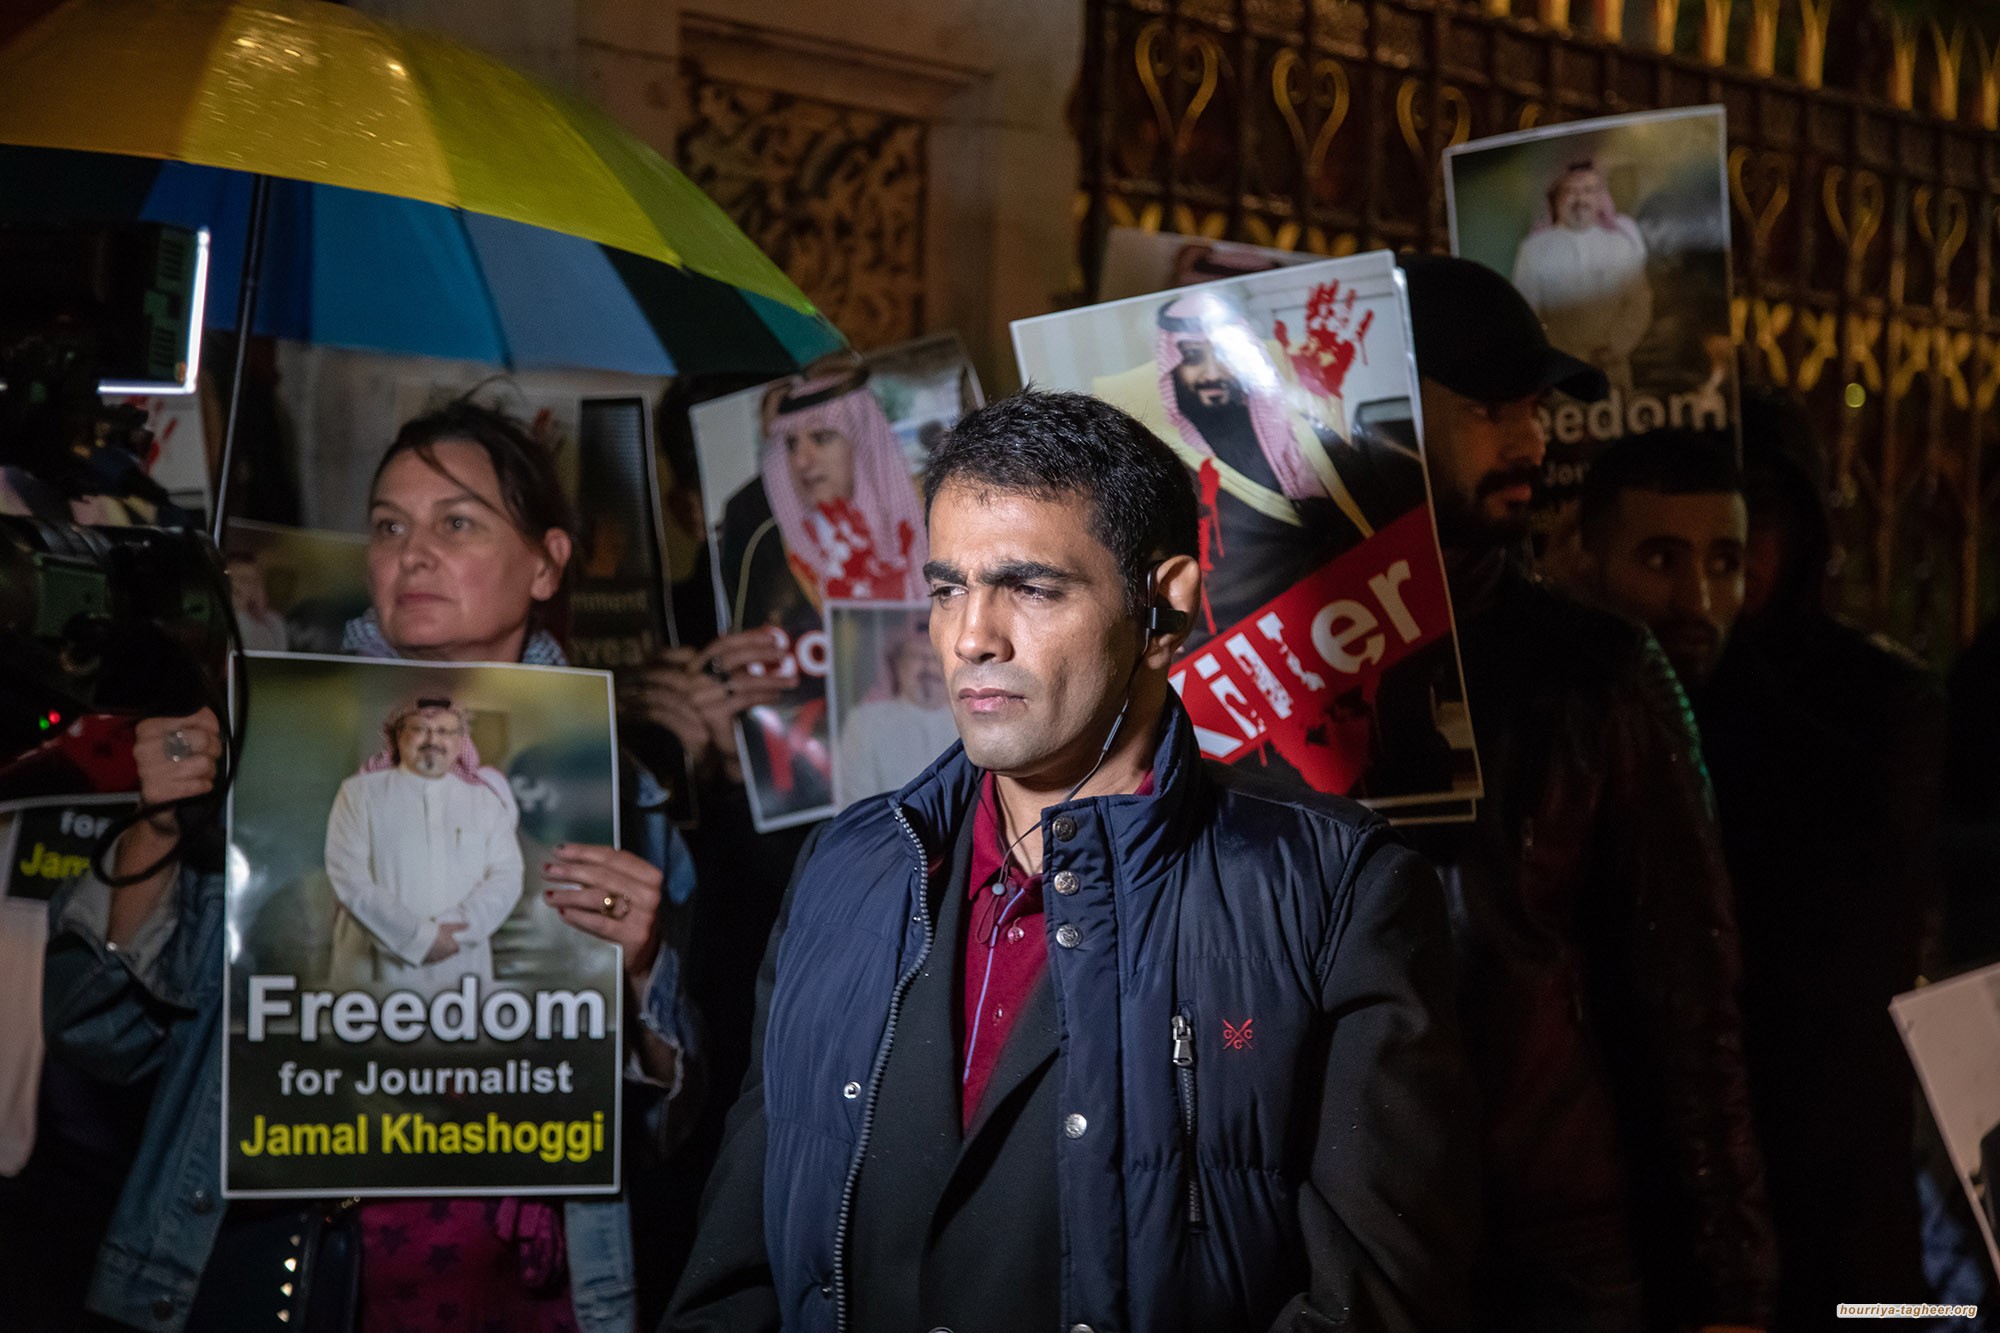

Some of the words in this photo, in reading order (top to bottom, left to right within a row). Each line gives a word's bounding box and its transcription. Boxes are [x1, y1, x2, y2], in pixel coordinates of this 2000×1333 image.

[247, 973, 607, 1043] Freedom
[277, 1060, 343, 1096] for
[353, 1058, 575, 1096] Journalist
[239, 1112, 370, 1158] Jamal
[379, 1110, 606, 1164] Khashoggi
